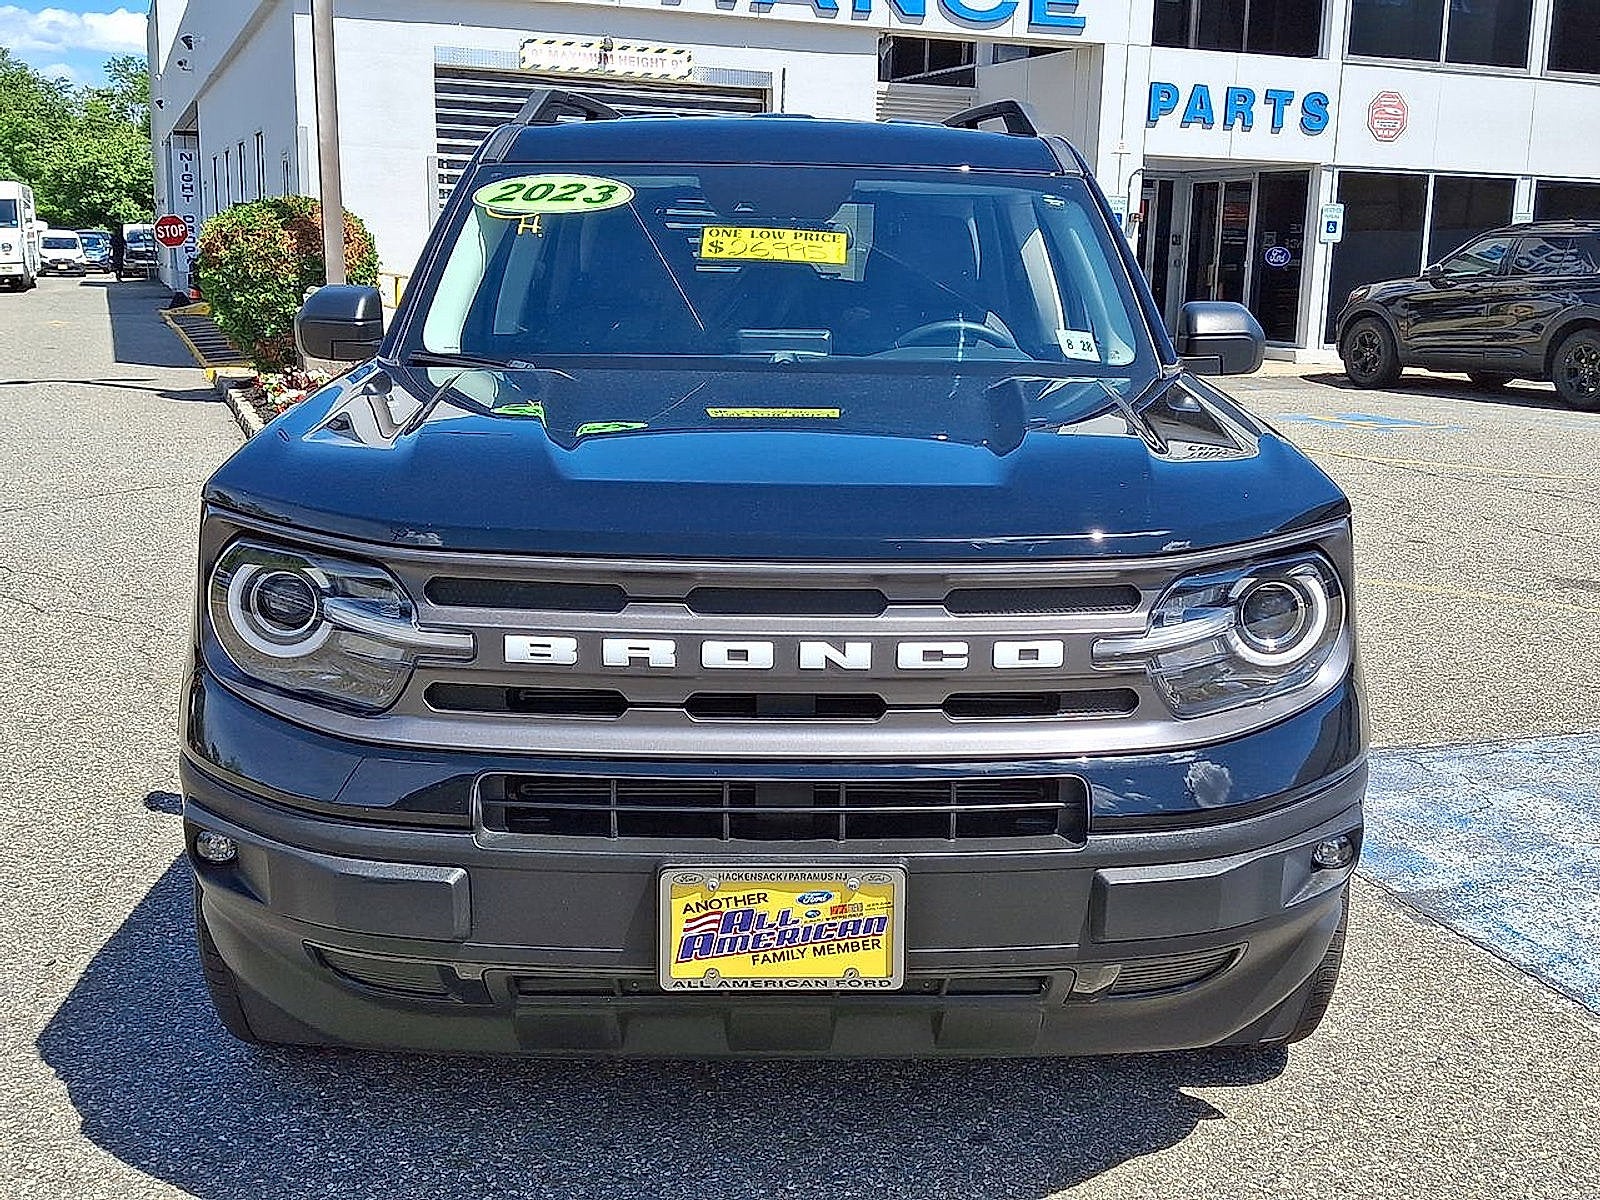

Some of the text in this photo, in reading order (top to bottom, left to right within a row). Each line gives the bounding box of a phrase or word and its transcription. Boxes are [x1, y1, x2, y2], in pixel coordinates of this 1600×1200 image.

[618, 54, 667, 69] HEIGHT
[1146, 81, 1330, 136] PARTS
[179, 152, 194, 203] NIGHT
[488, 183, 619, 204] 2023
[157, 224, 186, 239] STOP
[708, 228, 841, 243] ONE LOW PRICE
[1066, 338, 1074, 350] 8
[503, 635, 1064, 670] BRONCO
[682, 892, 769, 915] ANOTHER
[719, 908, 800, 936] ALL
[678, 916, 889, 960] AMERICAN
[751, 938, 881, 966] FAMILY MEMBER
[673, 979, 892, 989] ALL AMERICAN FORD
